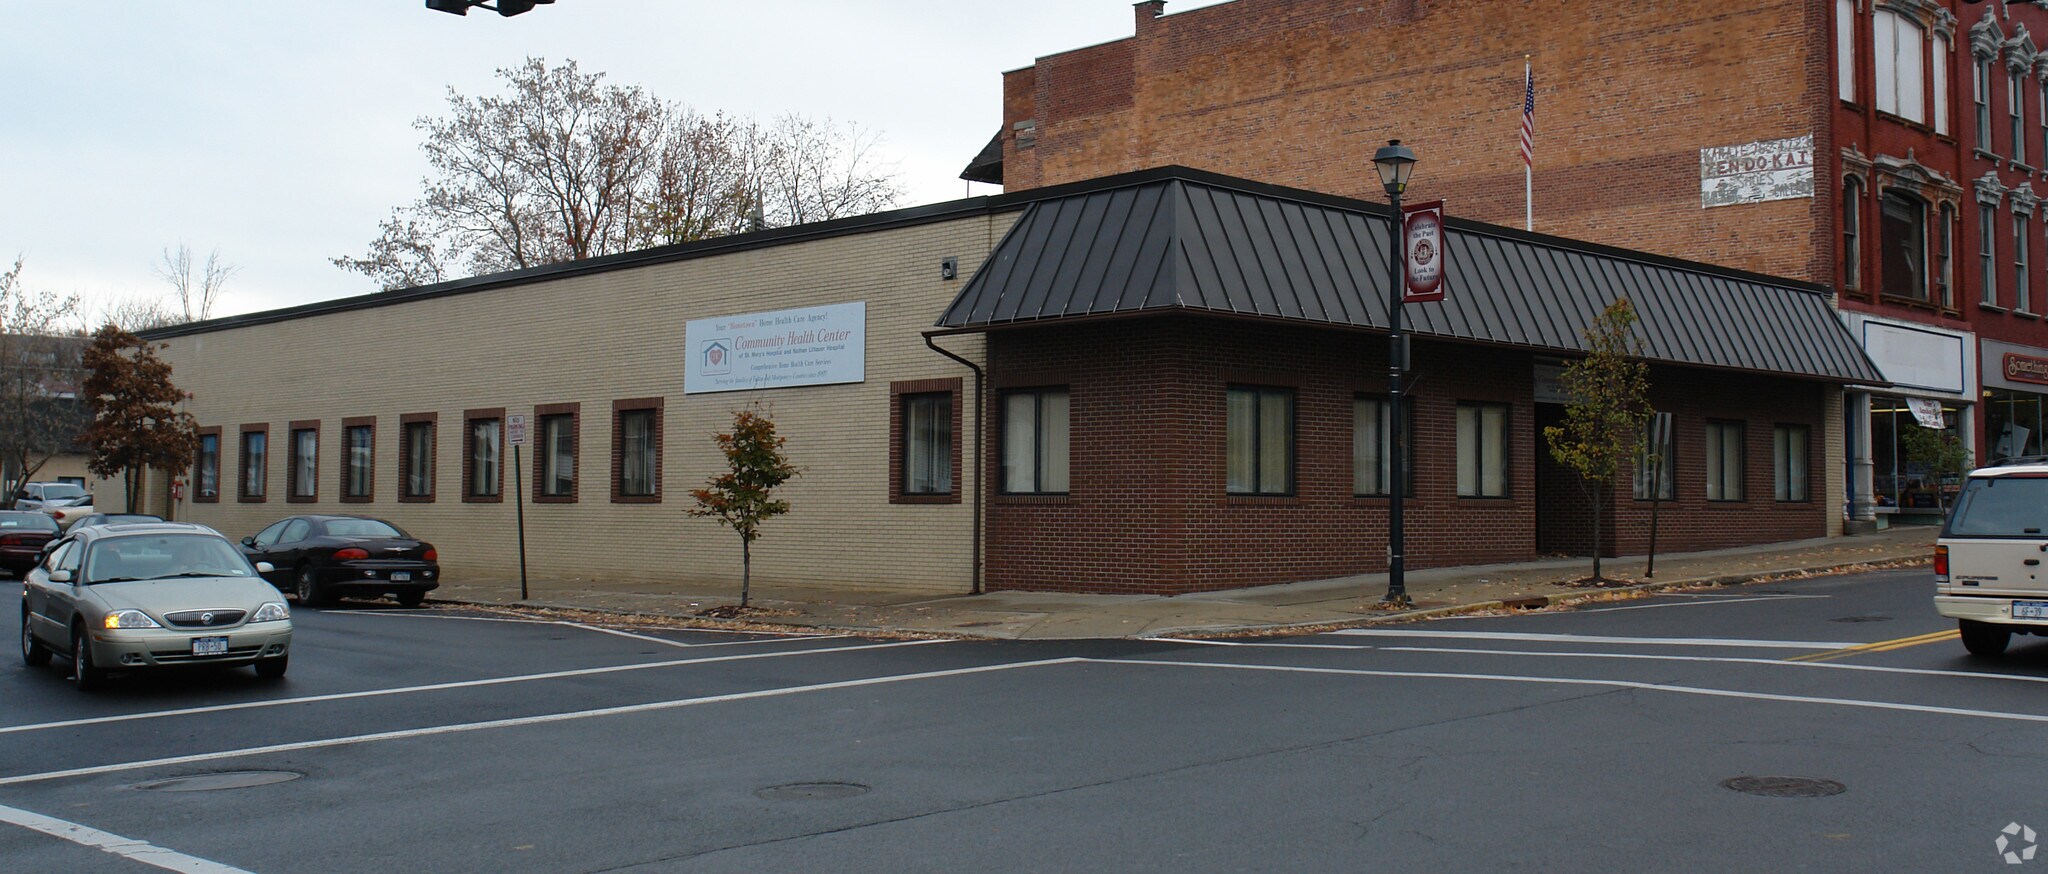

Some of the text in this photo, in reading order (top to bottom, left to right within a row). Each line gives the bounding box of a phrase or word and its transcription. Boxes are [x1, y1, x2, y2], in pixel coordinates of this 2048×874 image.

[1410, 222, 1436, 231] Celebrate
[1422, 230, 1434, 238] Past
[759, 319, 773, 327] Home
[775, 316, 791, 325] Health
[793, 314, 805, 323] Care
[735, 328, 851, 350] Community Health Center
[766, 347, 782, 356] Hospital
[2009, 356, 2048, 379] Something
